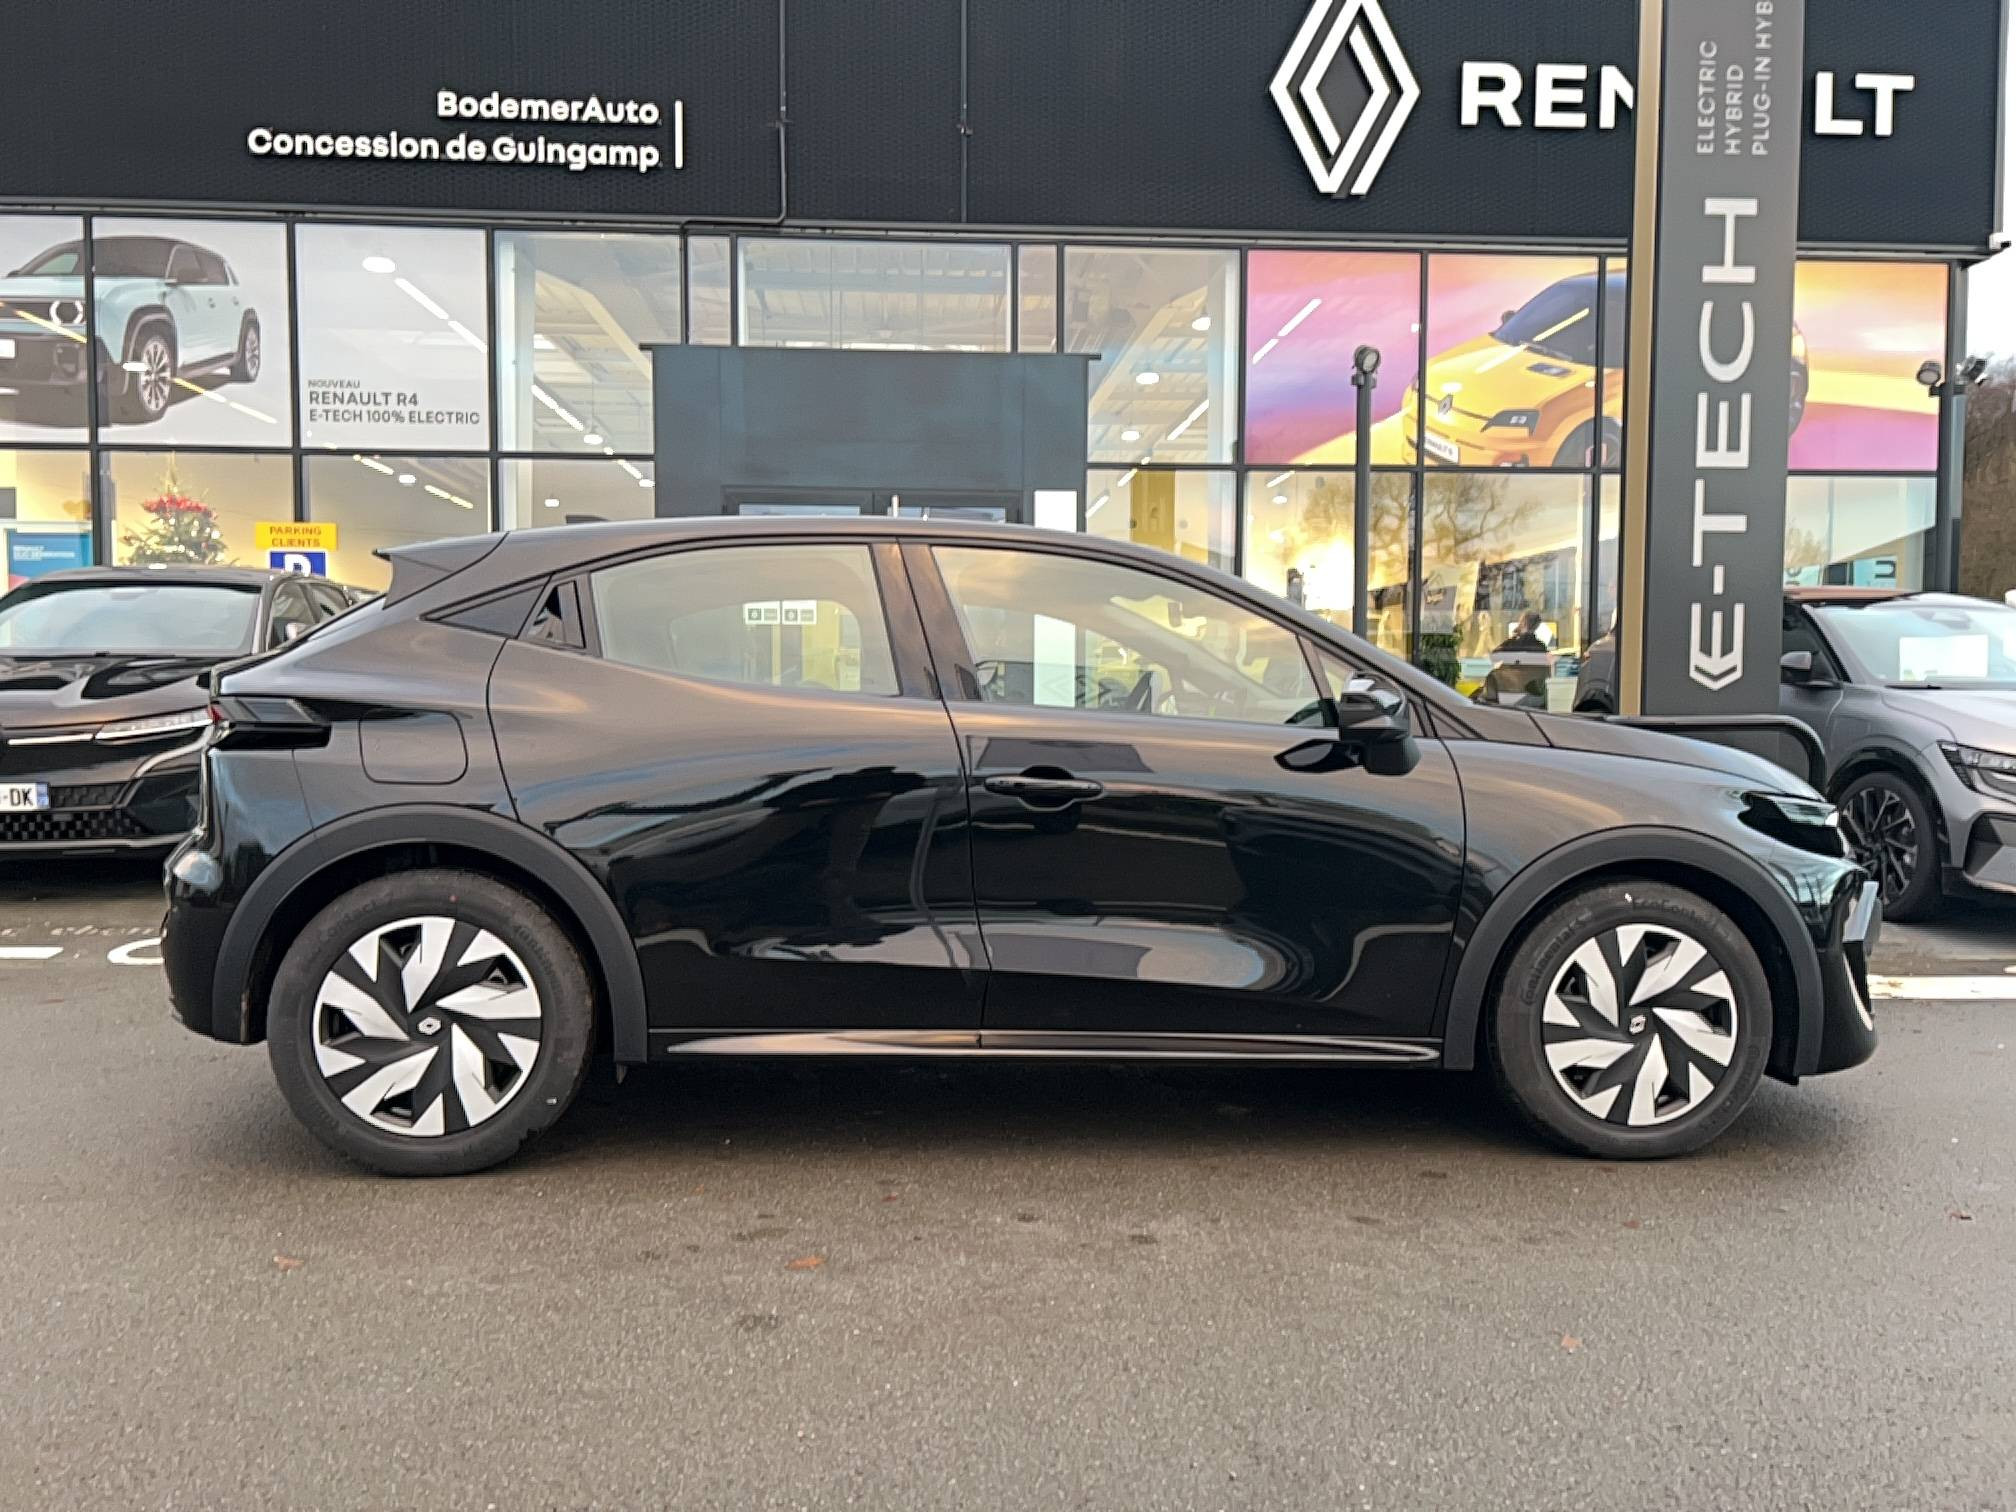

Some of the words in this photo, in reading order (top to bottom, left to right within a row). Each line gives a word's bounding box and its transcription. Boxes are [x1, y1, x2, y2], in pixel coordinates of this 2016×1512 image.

[436, 90, 661, 125] BodemerAuto
[1697, 40, 1718, 155] ELECTRIC
[1725, 64, 1744, 155] HYBRID
[1752, 56, 1772, 156] PLUG-IN
[247, 127, 440, 159] Concession
[445, 132, 487, 161] de
[492, 135, 661, 172] Guingamp
[308, 379, 361, 389] NOUVEAU
[309, 391, 392, 406] RENAULT
[397, 392, 419, 407] R4
[309, 408, 363, 423] E-TECH
[367, 410, 405, 424] 100%
[408, 411, 480, 425] ELECTRIC
[1688, 197, 1759, 691] E-TECH
[269, 525, 322, 536] PARKING
[271, 538, 321, 548] CLIENTS
